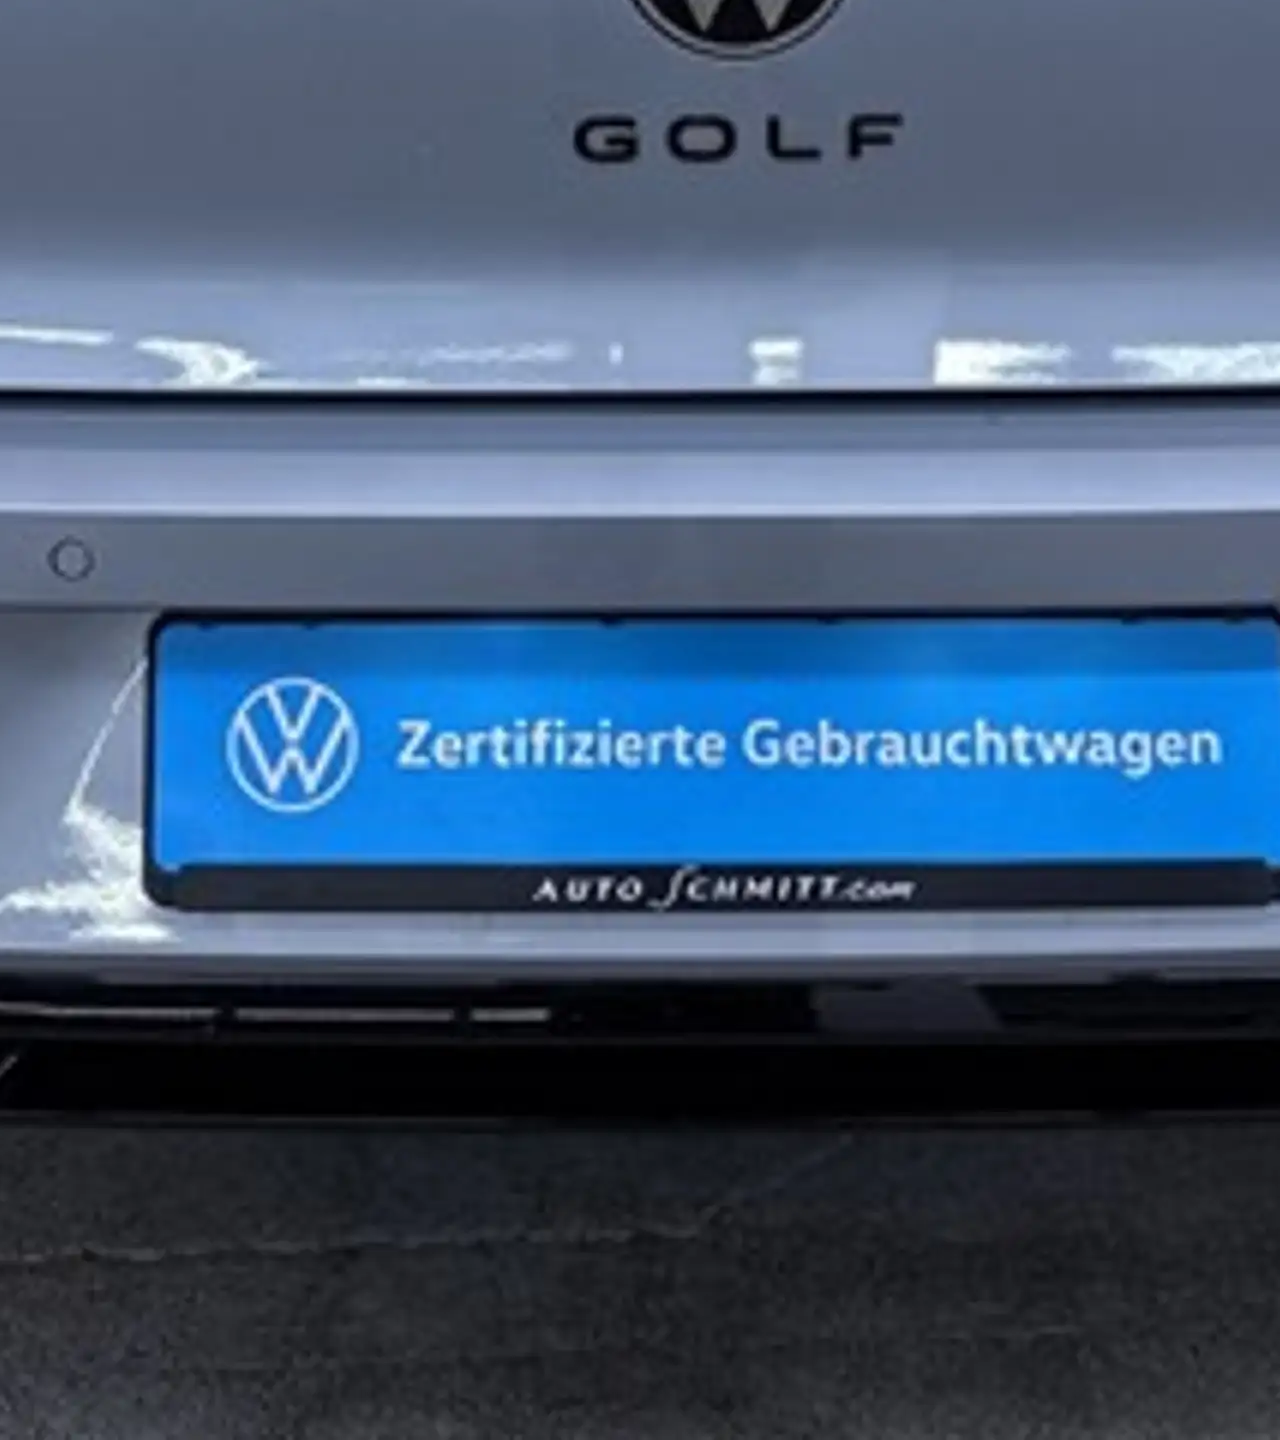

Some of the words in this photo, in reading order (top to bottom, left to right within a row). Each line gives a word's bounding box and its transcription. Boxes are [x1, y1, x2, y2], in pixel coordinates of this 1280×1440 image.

[572, 113, 904, 162] GOLF
[396, 718, 727, 769] Zertifizierte
[741, 717, 1223, 780] Gebrauchtwagen
[532, 875, 643, 903] AUTO
